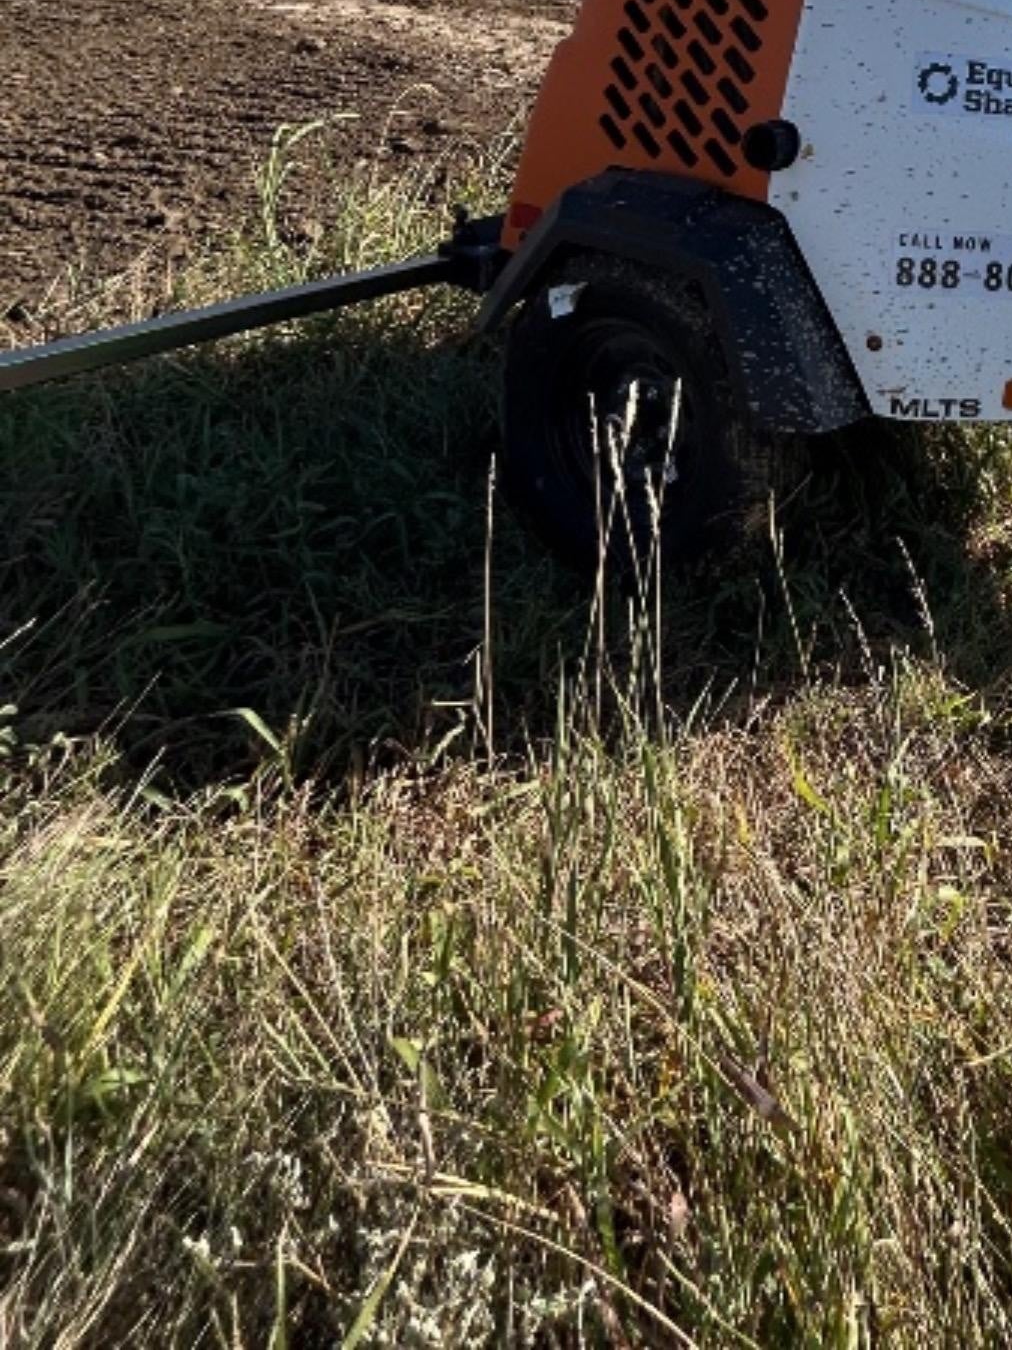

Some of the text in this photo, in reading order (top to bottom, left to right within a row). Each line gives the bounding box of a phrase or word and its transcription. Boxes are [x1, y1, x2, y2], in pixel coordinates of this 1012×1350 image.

[899, 233, 992, 252] CALL NOW
[889, 396, 982, 418] MLTS
